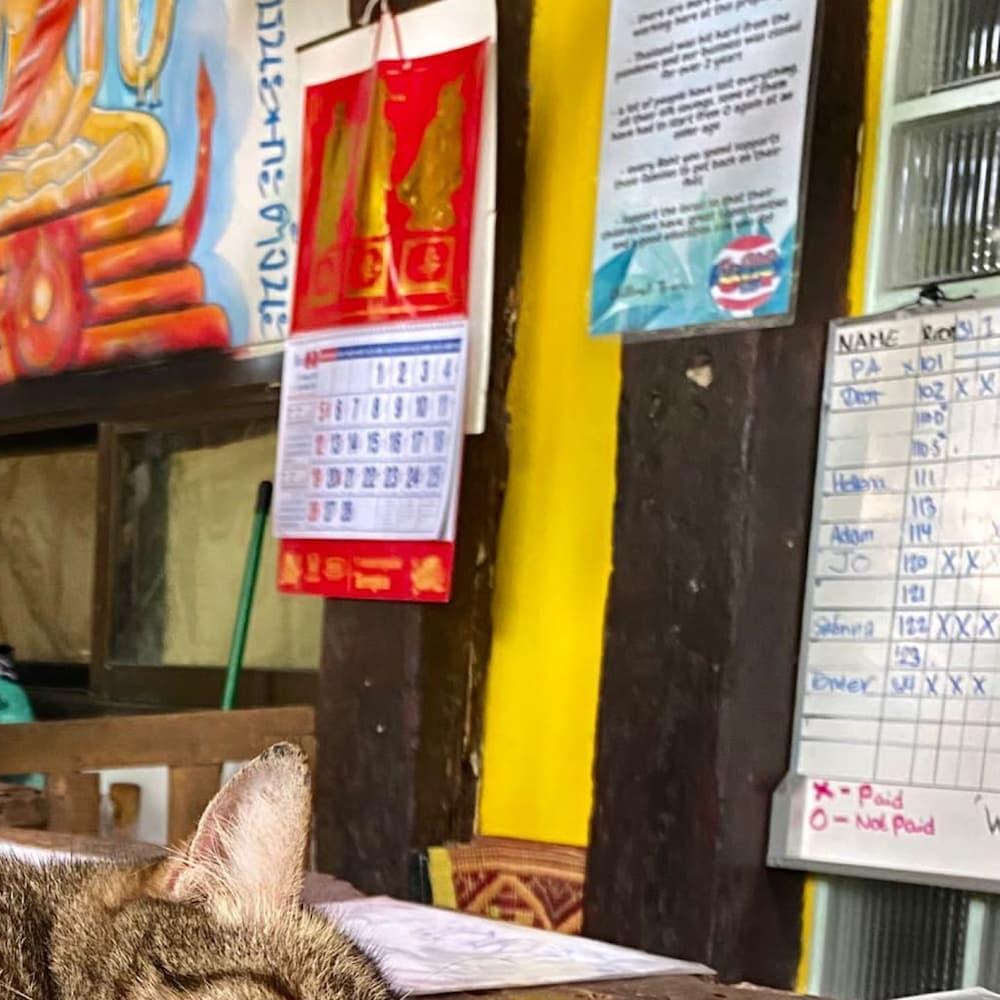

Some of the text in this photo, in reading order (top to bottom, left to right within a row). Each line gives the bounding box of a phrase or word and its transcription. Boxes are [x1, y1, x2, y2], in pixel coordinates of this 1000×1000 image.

[716, 24, 740, 39] hard
[838, 329, 900, 351] NAME
[376, 361, 384, 385] 1
[397, 360, 407, 384] 2
[420, 359, 430, 383] 3
[372, 396, 381, 420] 8
[394, 397, 404, 419] 9
[367, 431, 380, 454] 15
[909, 522, 933, 543] 114
[858, 784, 905, 809] Paid
[892, 814, 936, 838] Paid
